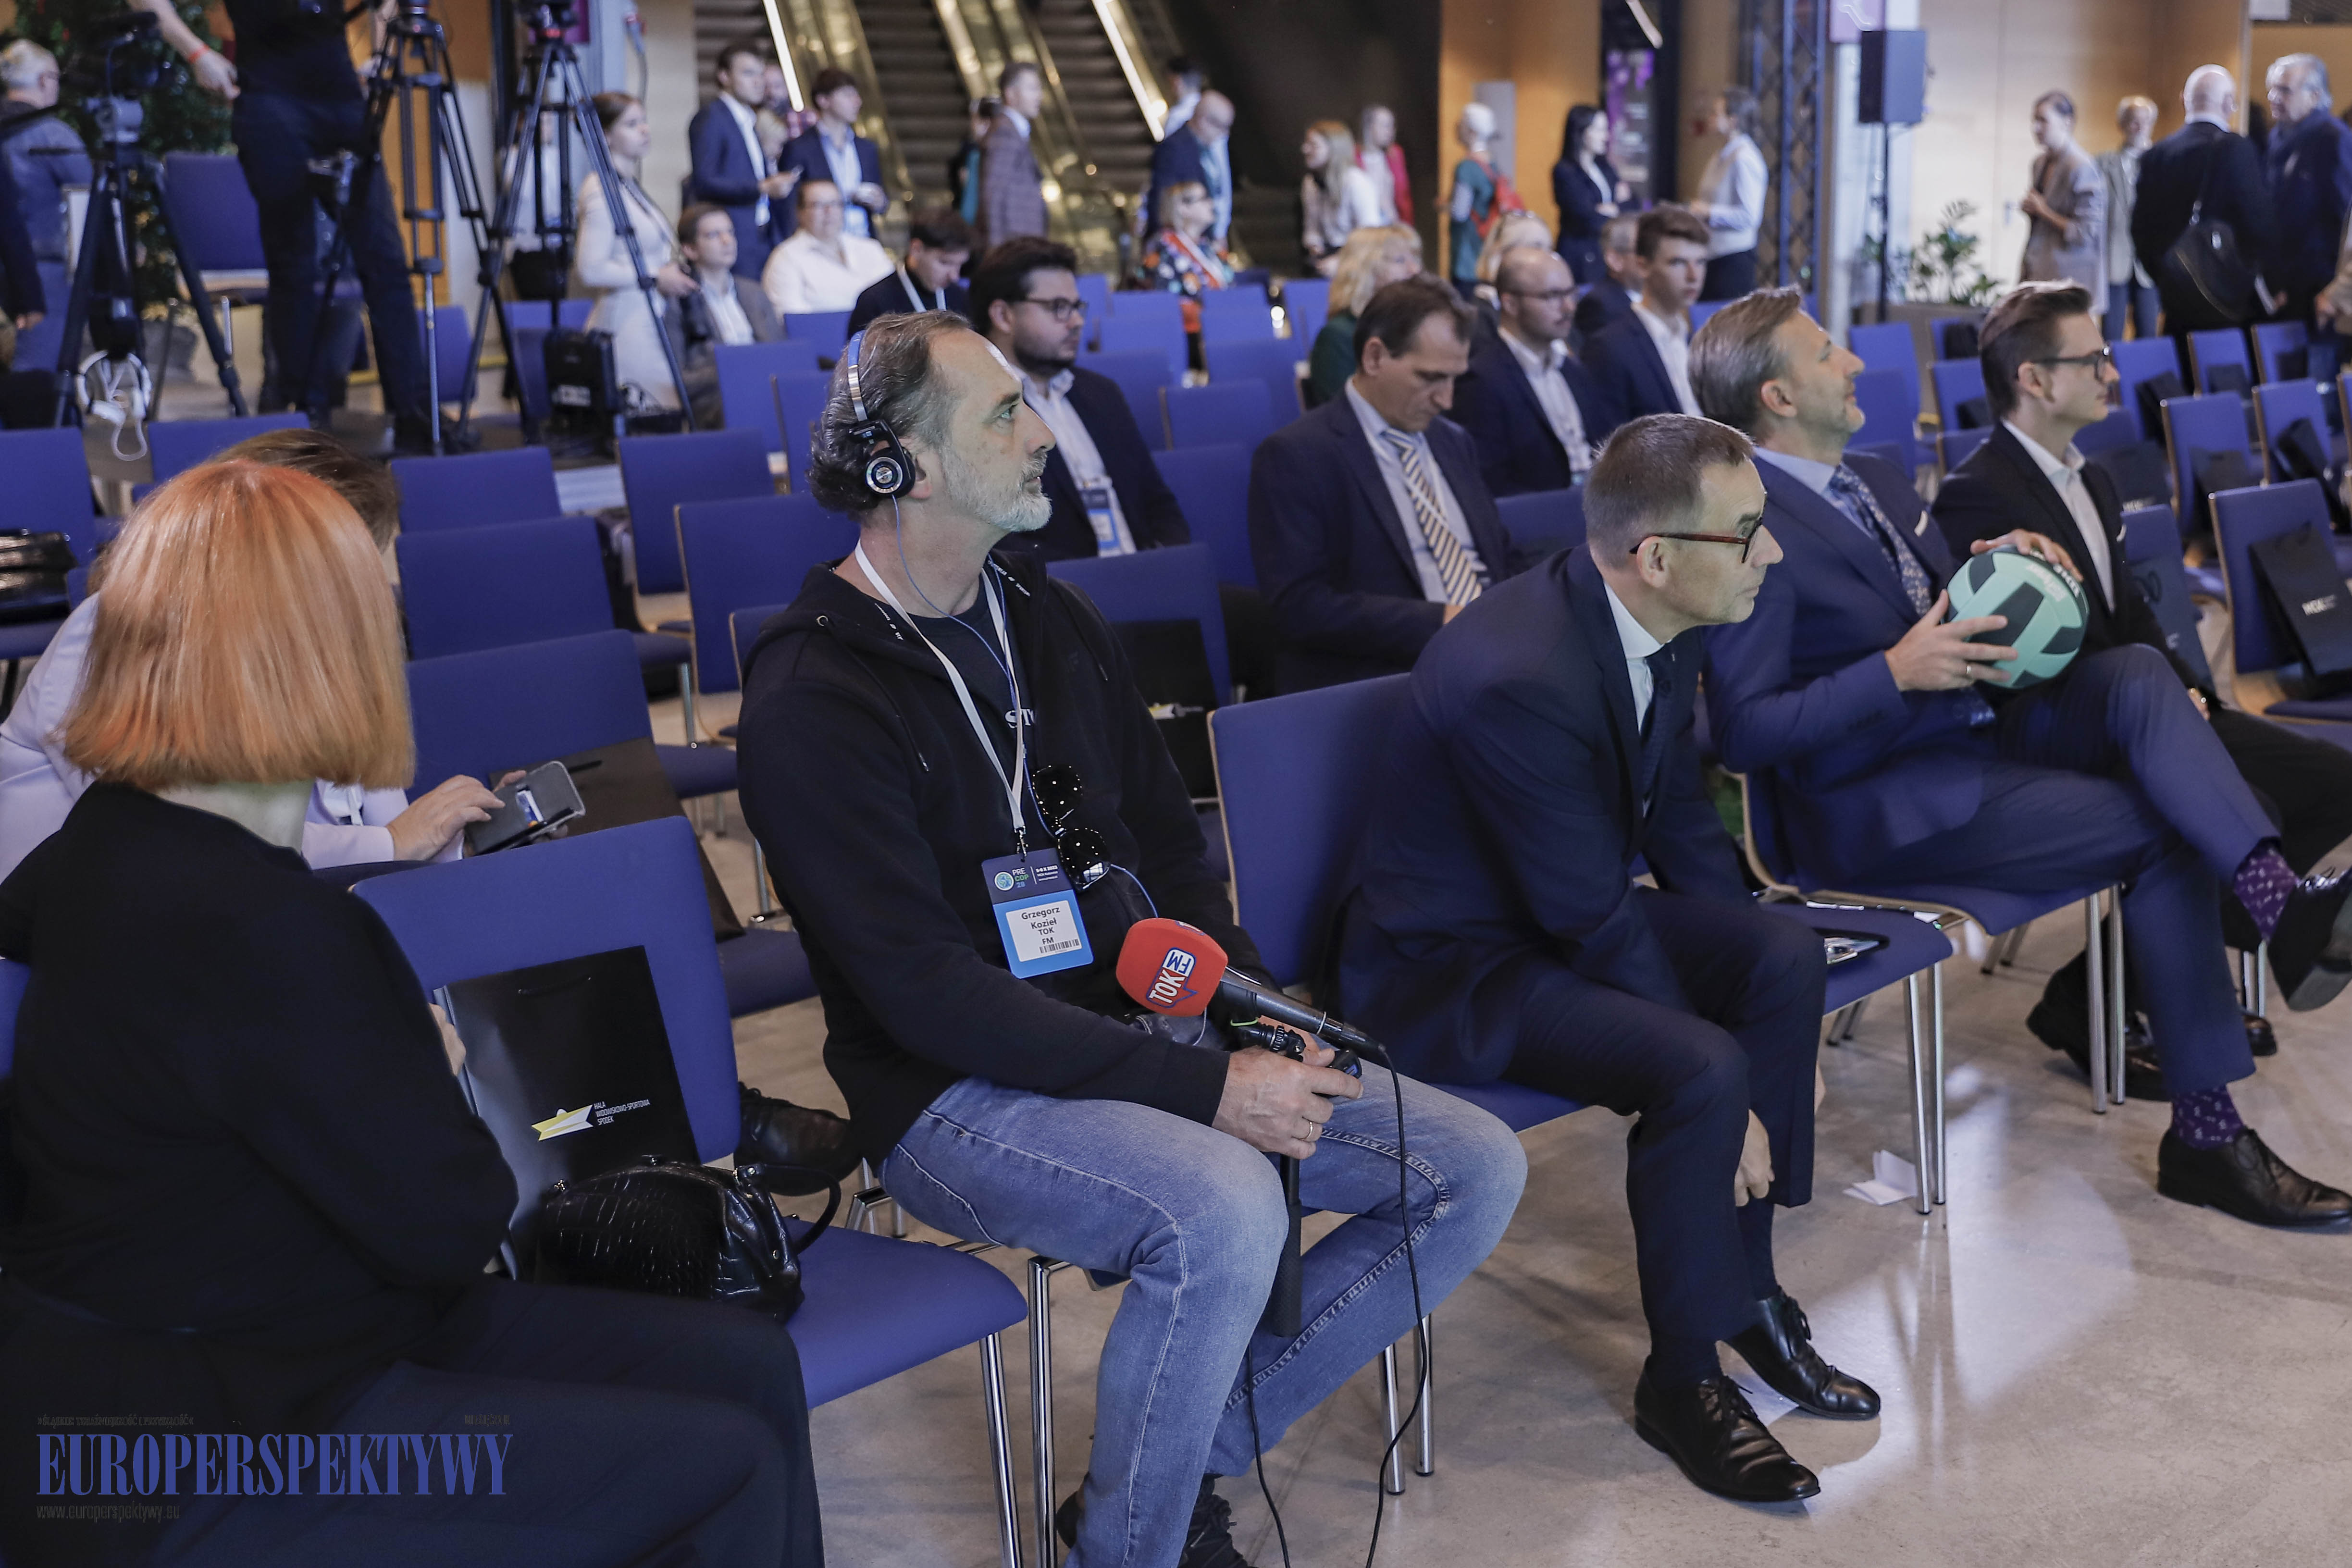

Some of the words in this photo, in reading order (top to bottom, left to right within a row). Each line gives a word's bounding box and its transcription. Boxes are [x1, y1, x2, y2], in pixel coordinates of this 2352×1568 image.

[1012, 867, 1026, 875] PRE
[1021, 906, 1061, 920] Grzegorz
[1030, 918, 1057, 929] Kozieł
[1038, 926, 1055, 935] TOK
[1042, 936, 1054, 945] FM
[1166, 951, 1191, 974] FM
[1149, 969, 1186, 1004] TOK
[594, 1101, 606, 1110] HALA
[597, 1115, 614, 1125] SPODEK
